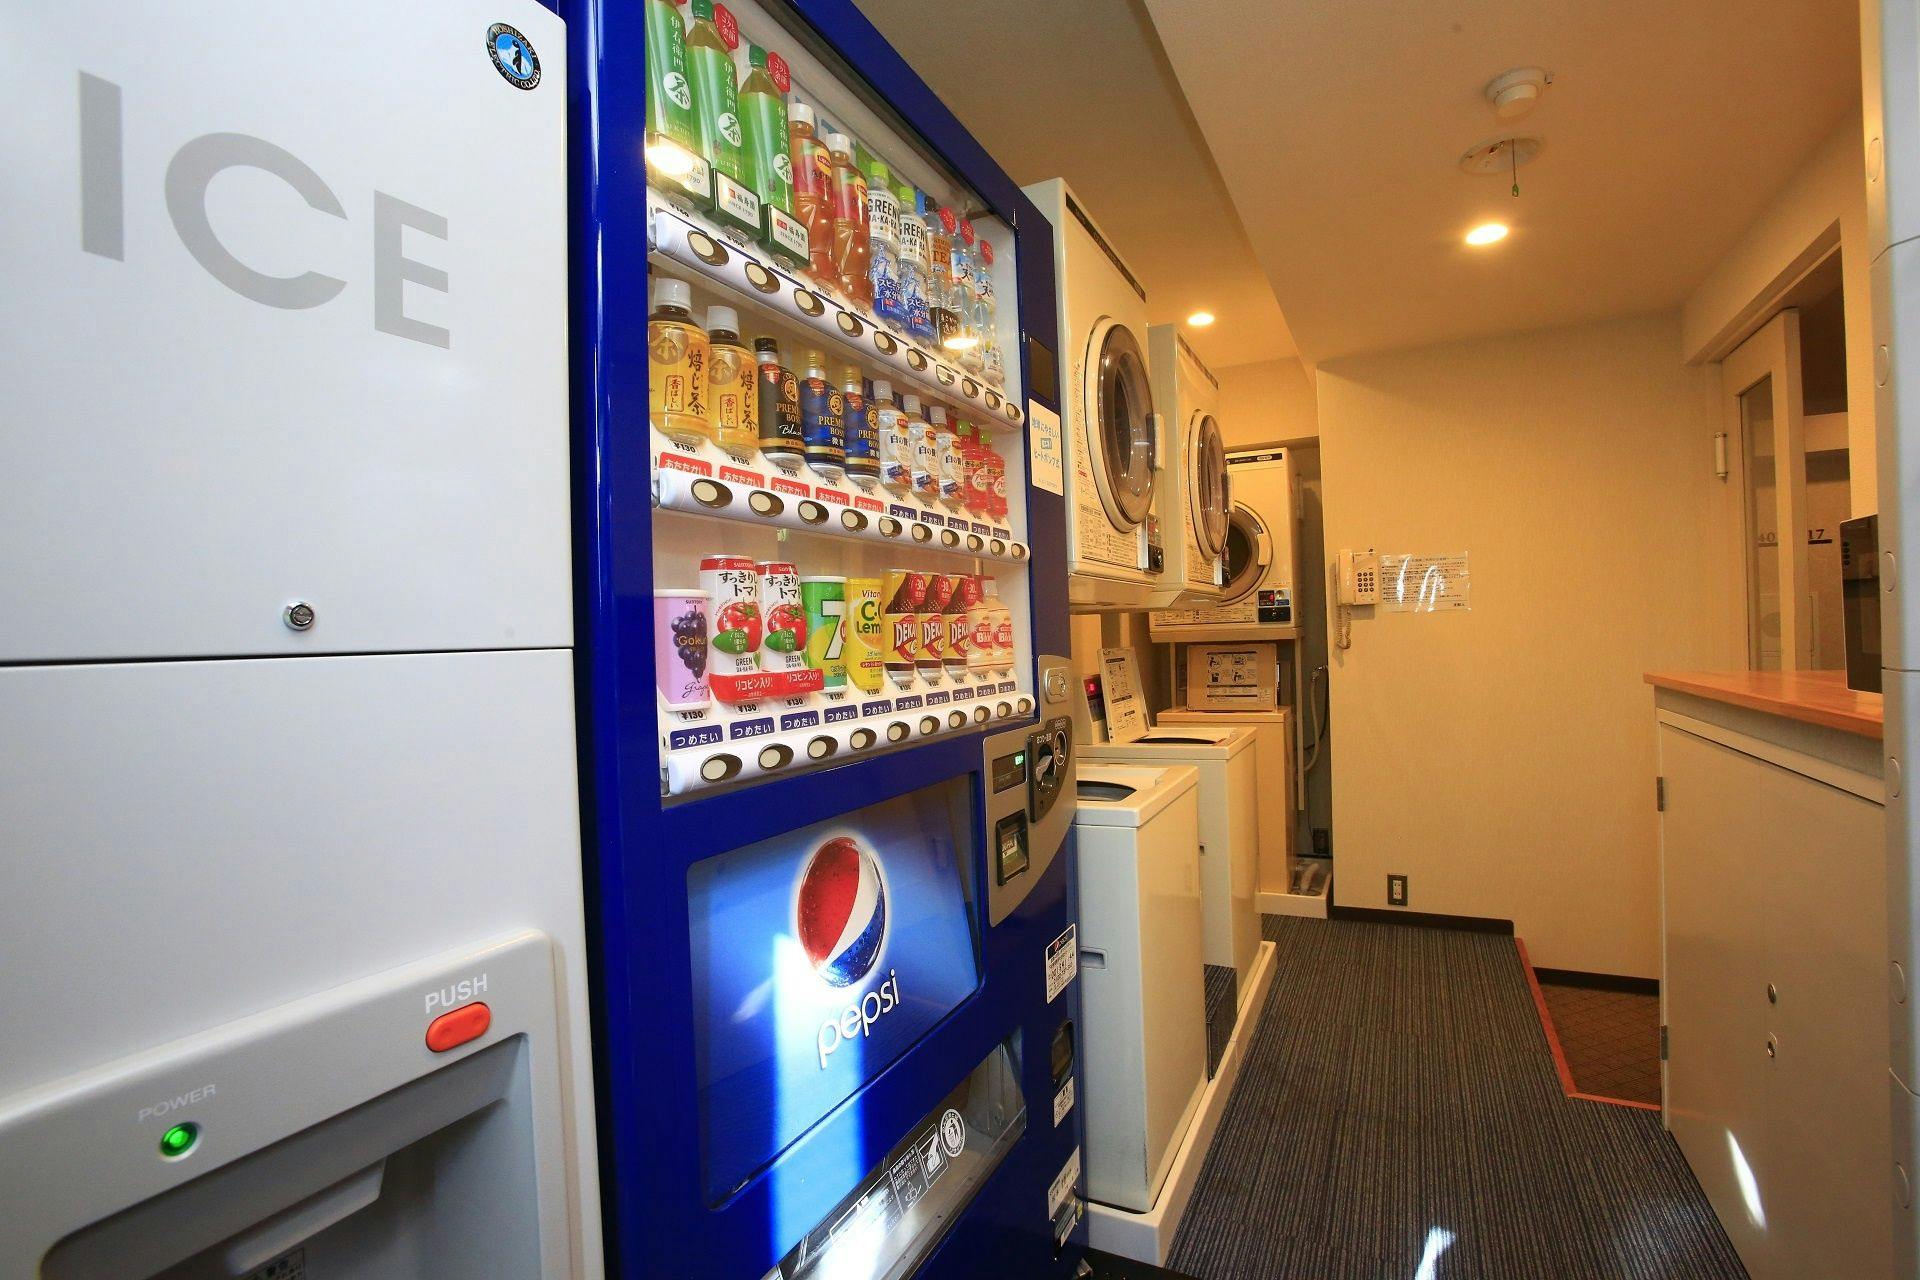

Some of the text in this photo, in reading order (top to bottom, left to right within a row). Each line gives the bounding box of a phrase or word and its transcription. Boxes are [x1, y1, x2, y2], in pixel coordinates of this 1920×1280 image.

[78, 70, 450, 349] ICE
[688, 349, 705, 415] 焙じ茶
[740, 370, 757, 432] 焙じ茶
[673, 442, 696, 454] ¥130
[730, 455, 750, 466] ¥130
[892, 509, 915, 520] つめたい
[922, 516, 943, 526] つめたい
[1808, 528, 1825, 541] 17
[821, 599, 846, 661] 7
[736, 657, 753, 667] GREEN
[785, 655, 801, 664] GREEN
[829, 692, 845, 701] ¥130
[866, 687, 880, 696] ¥130
[786, 697, 804, 706] ¥130
[898, 699, 922, 709] つめたい
[928, 695, 949, 705] つめたい
[738, 703, 757, 713] ¥130
[865, 704, 890, 716] つめたい
[681, 710, 704, 721] ¥130
[827, 710, 856, 722] つめたい
[784, 716, 816, 729] つめたい
[734, 723, 771, 737] つめたい
[675, 732, 719, 747] つめたい
[425, 973, 489, 1014] PUSH
[817, 968, 900, 1070] pepsi
[138, 1083, 218, 1123] POWER
